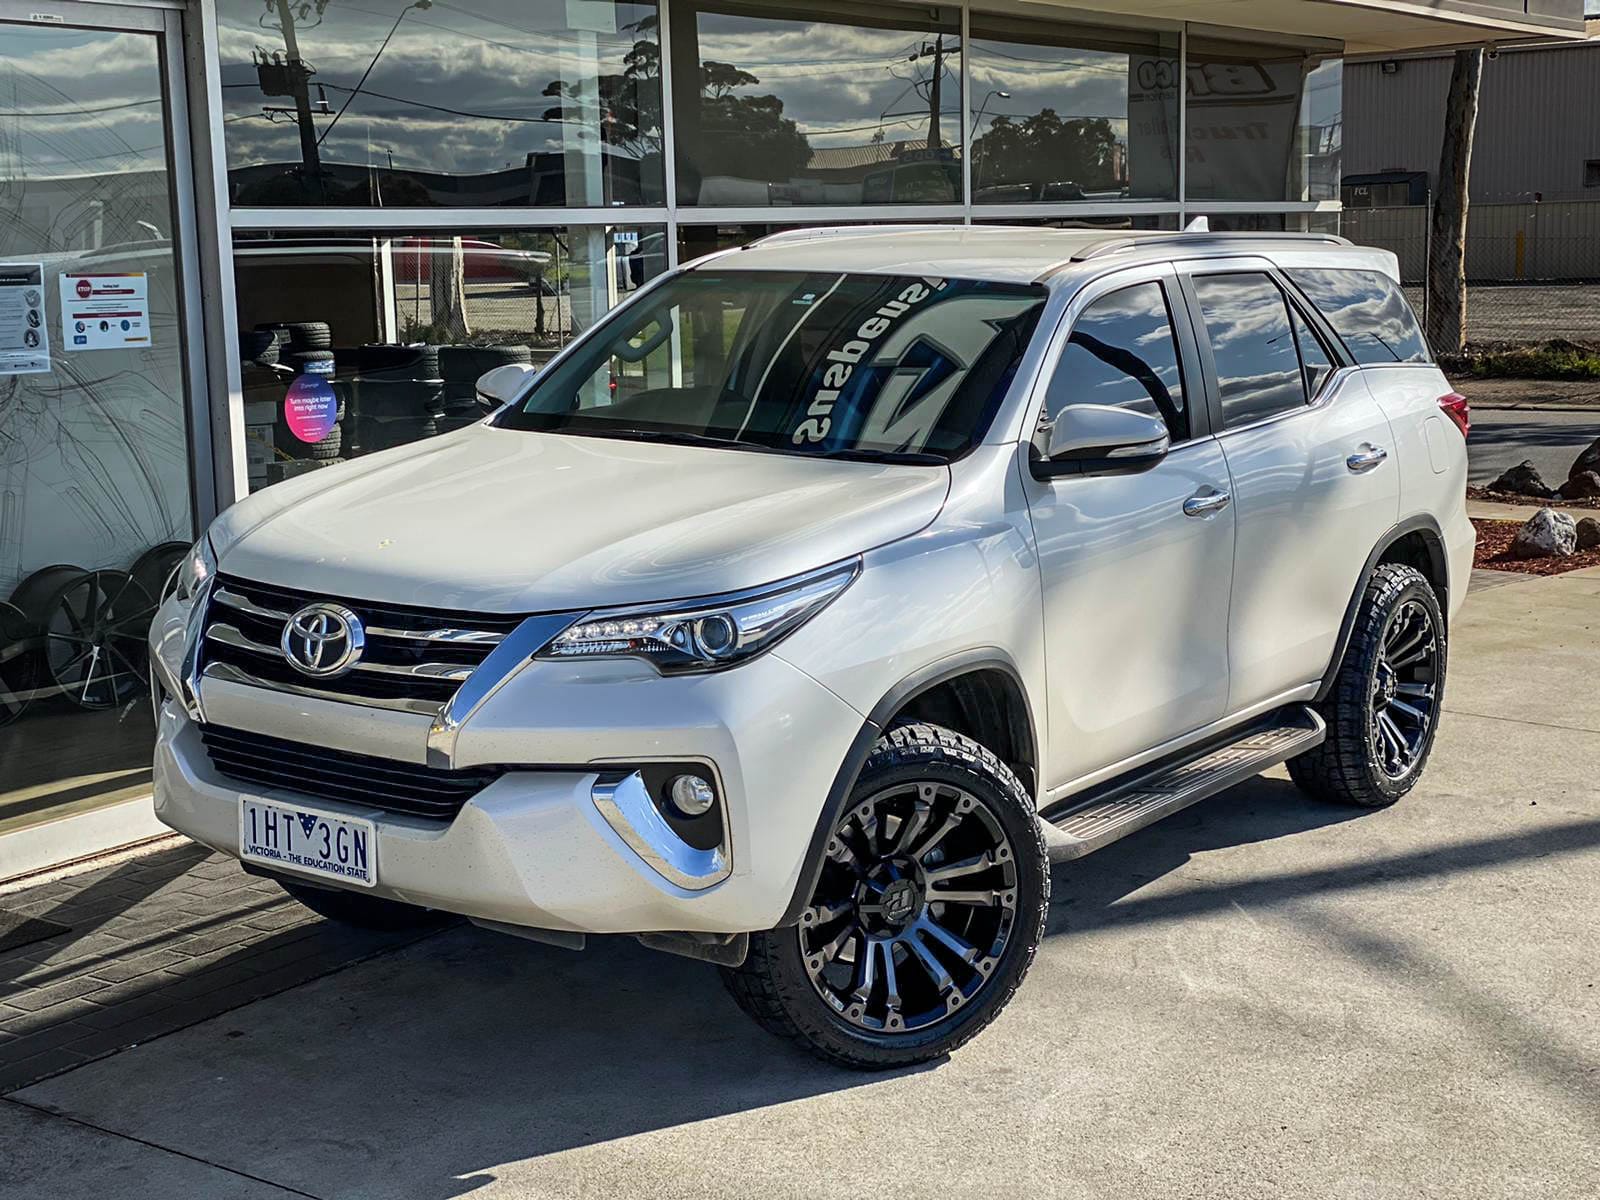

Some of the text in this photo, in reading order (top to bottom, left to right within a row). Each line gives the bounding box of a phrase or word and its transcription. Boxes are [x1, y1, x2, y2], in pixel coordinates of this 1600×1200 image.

[304, 404, 317, 412] right
[250, 808, 367, 869] 1HT 3GN
[248, 845, 281, 859] VICTORIA
[288, 854, 302, 864] THE
[303, 857, 345, 874] EDUCATION
[346, 866, 367, 881] STATE
